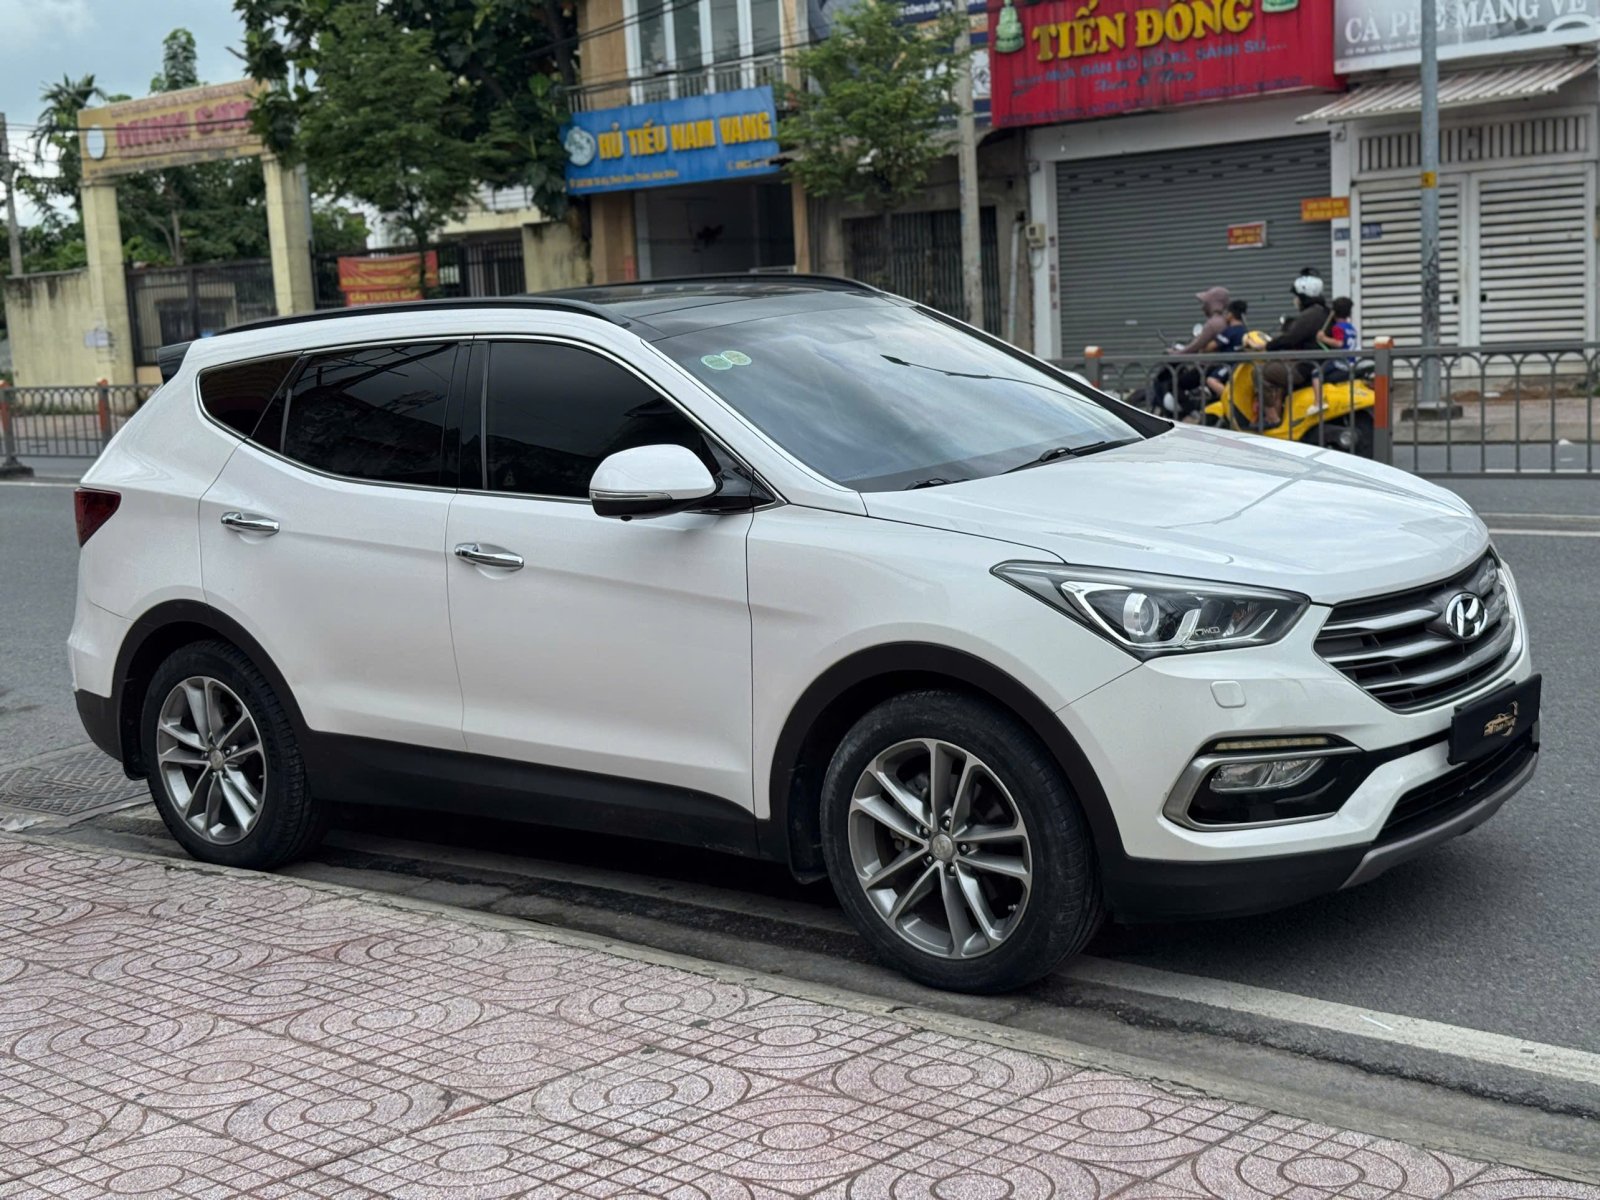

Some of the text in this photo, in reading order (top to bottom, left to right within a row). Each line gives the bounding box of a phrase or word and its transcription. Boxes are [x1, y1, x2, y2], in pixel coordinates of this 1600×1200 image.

[1032, 0, 1126, 61] TIẾN
[1344, 7, 1381, 44] CÀ
[1455, 0, 1540, 28] MANG
[598, 111, 773, 160] HỦ TIẾU NAM VANG
